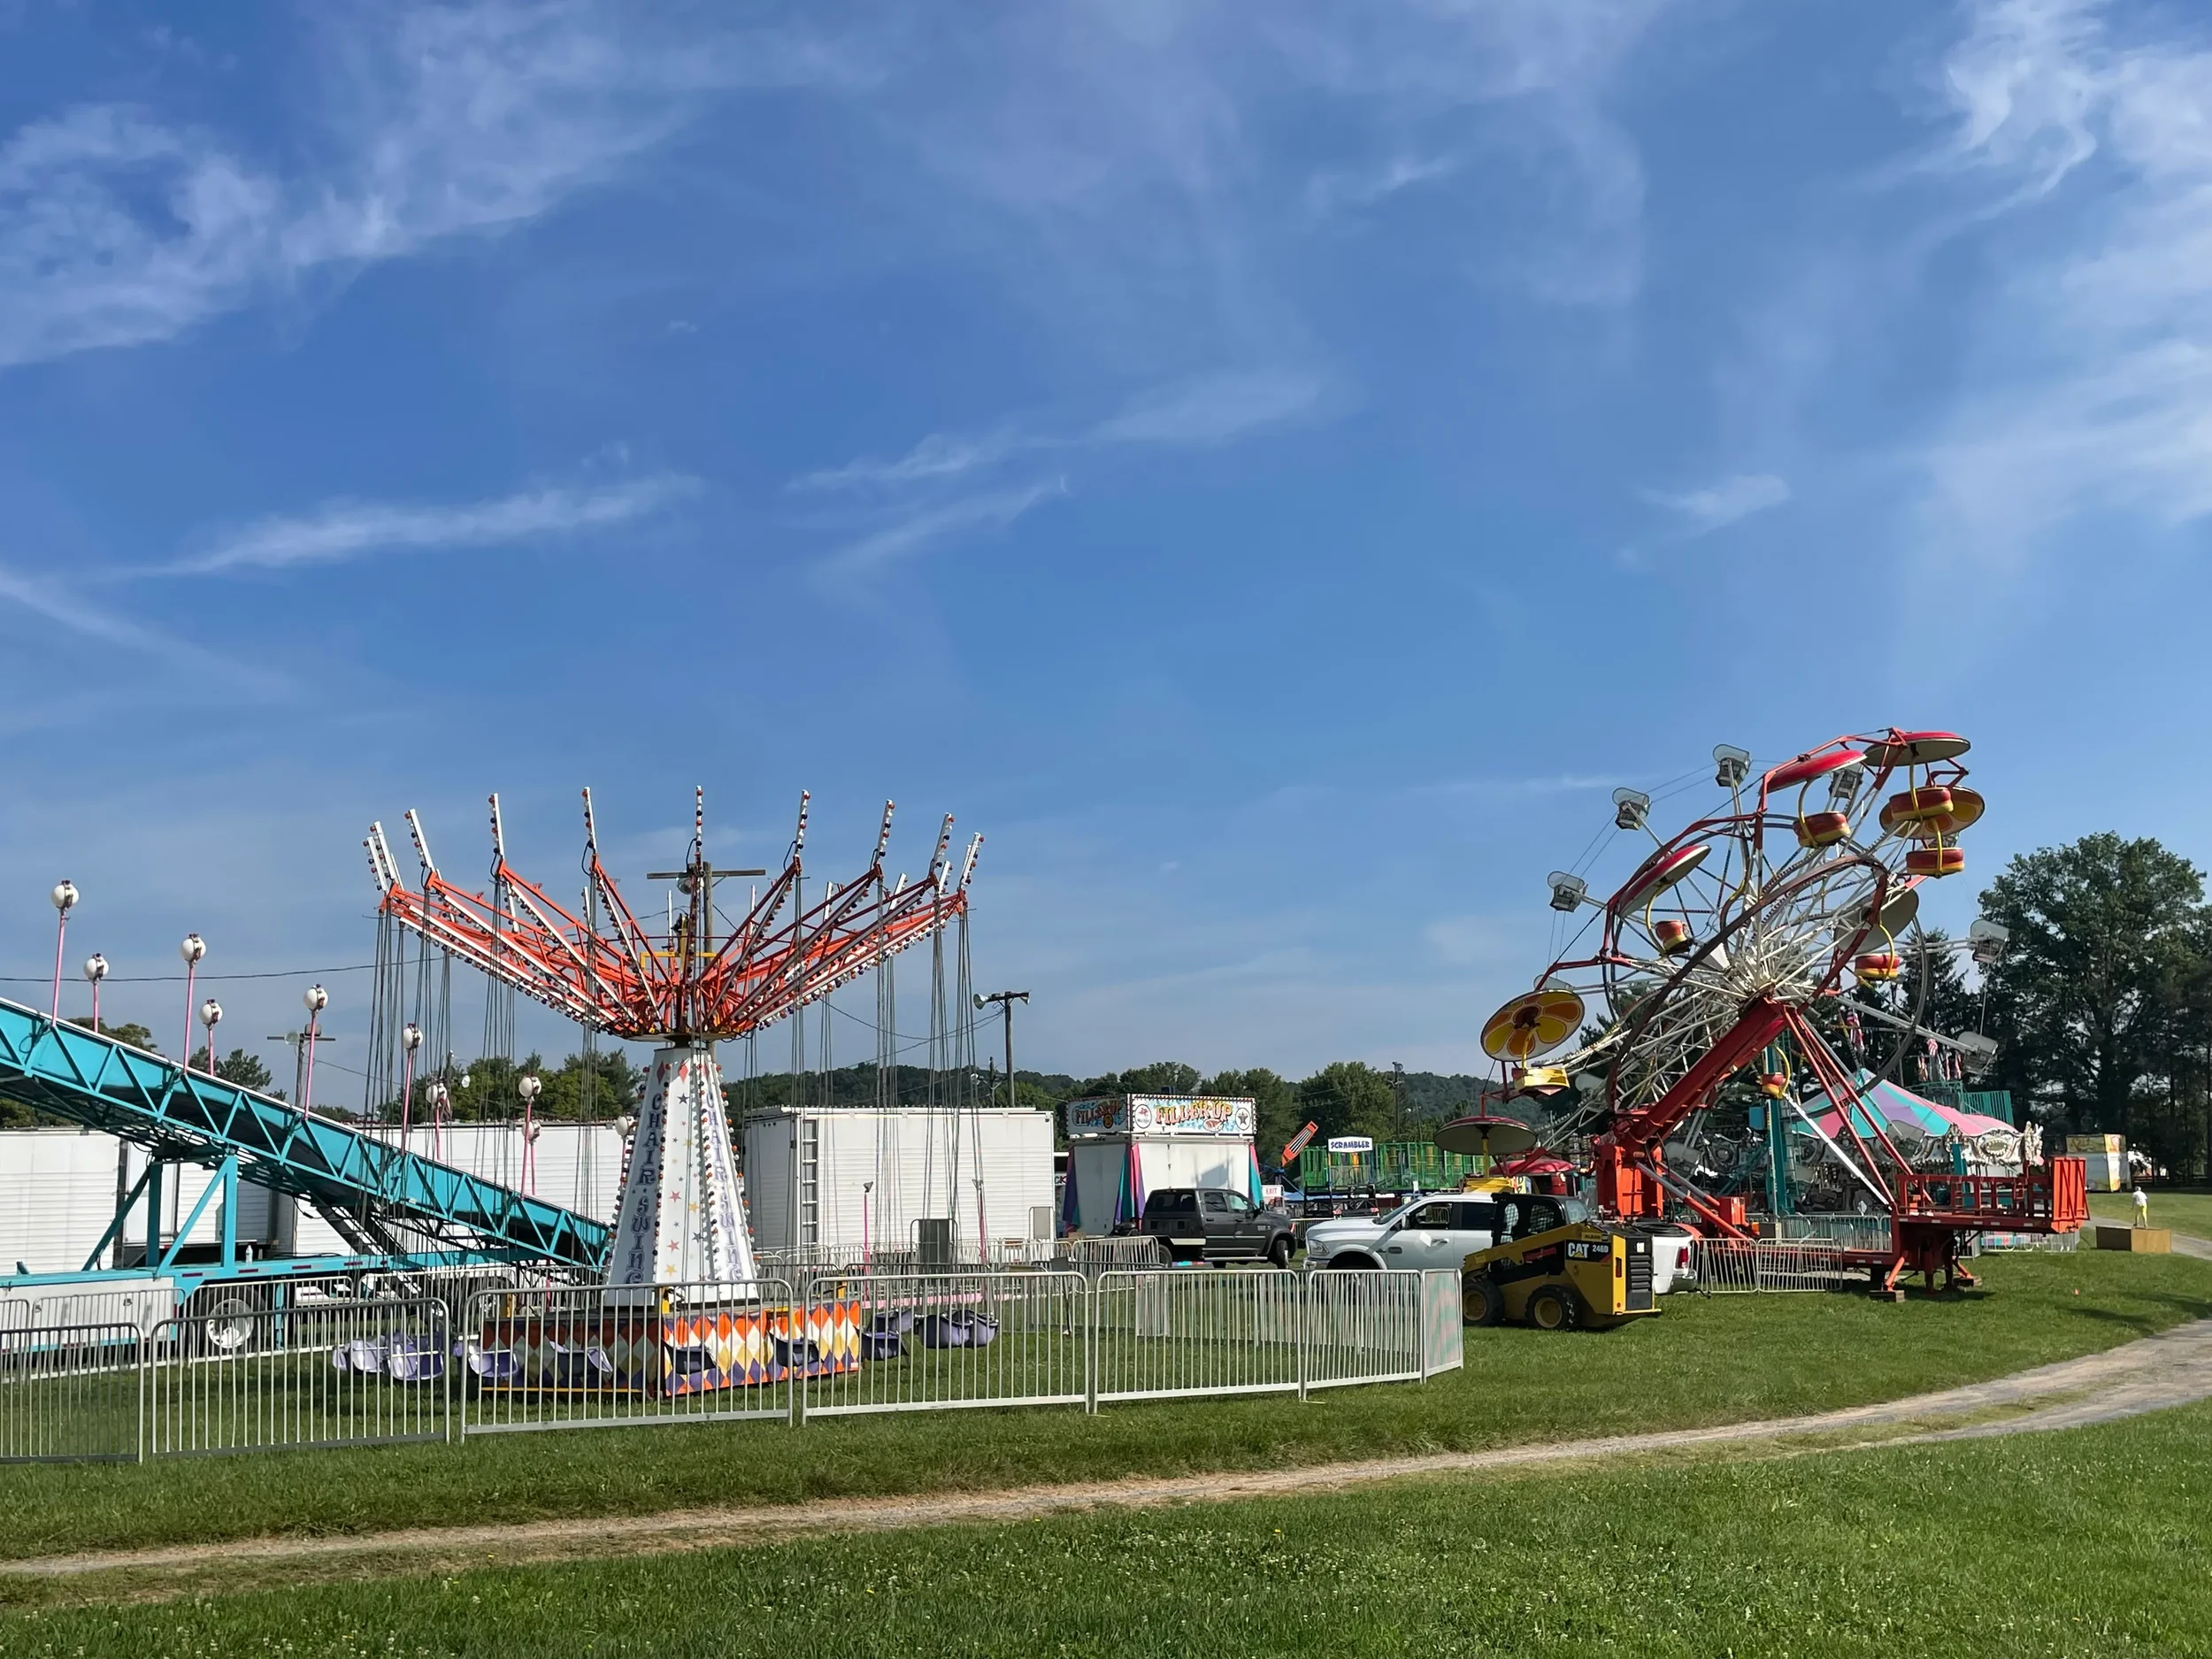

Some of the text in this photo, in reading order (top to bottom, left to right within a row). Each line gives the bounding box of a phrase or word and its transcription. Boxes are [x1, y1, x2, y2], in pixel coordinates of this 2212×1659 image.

[623, 1093, 662, 1291] CHAIR SWING
[708, 1092, 744, 1281] CHAIR SWING
[1330, 1141, 1370, 1149] SCRAMBLER
[1568, 1242, 1609, 1258] CAT 246D
